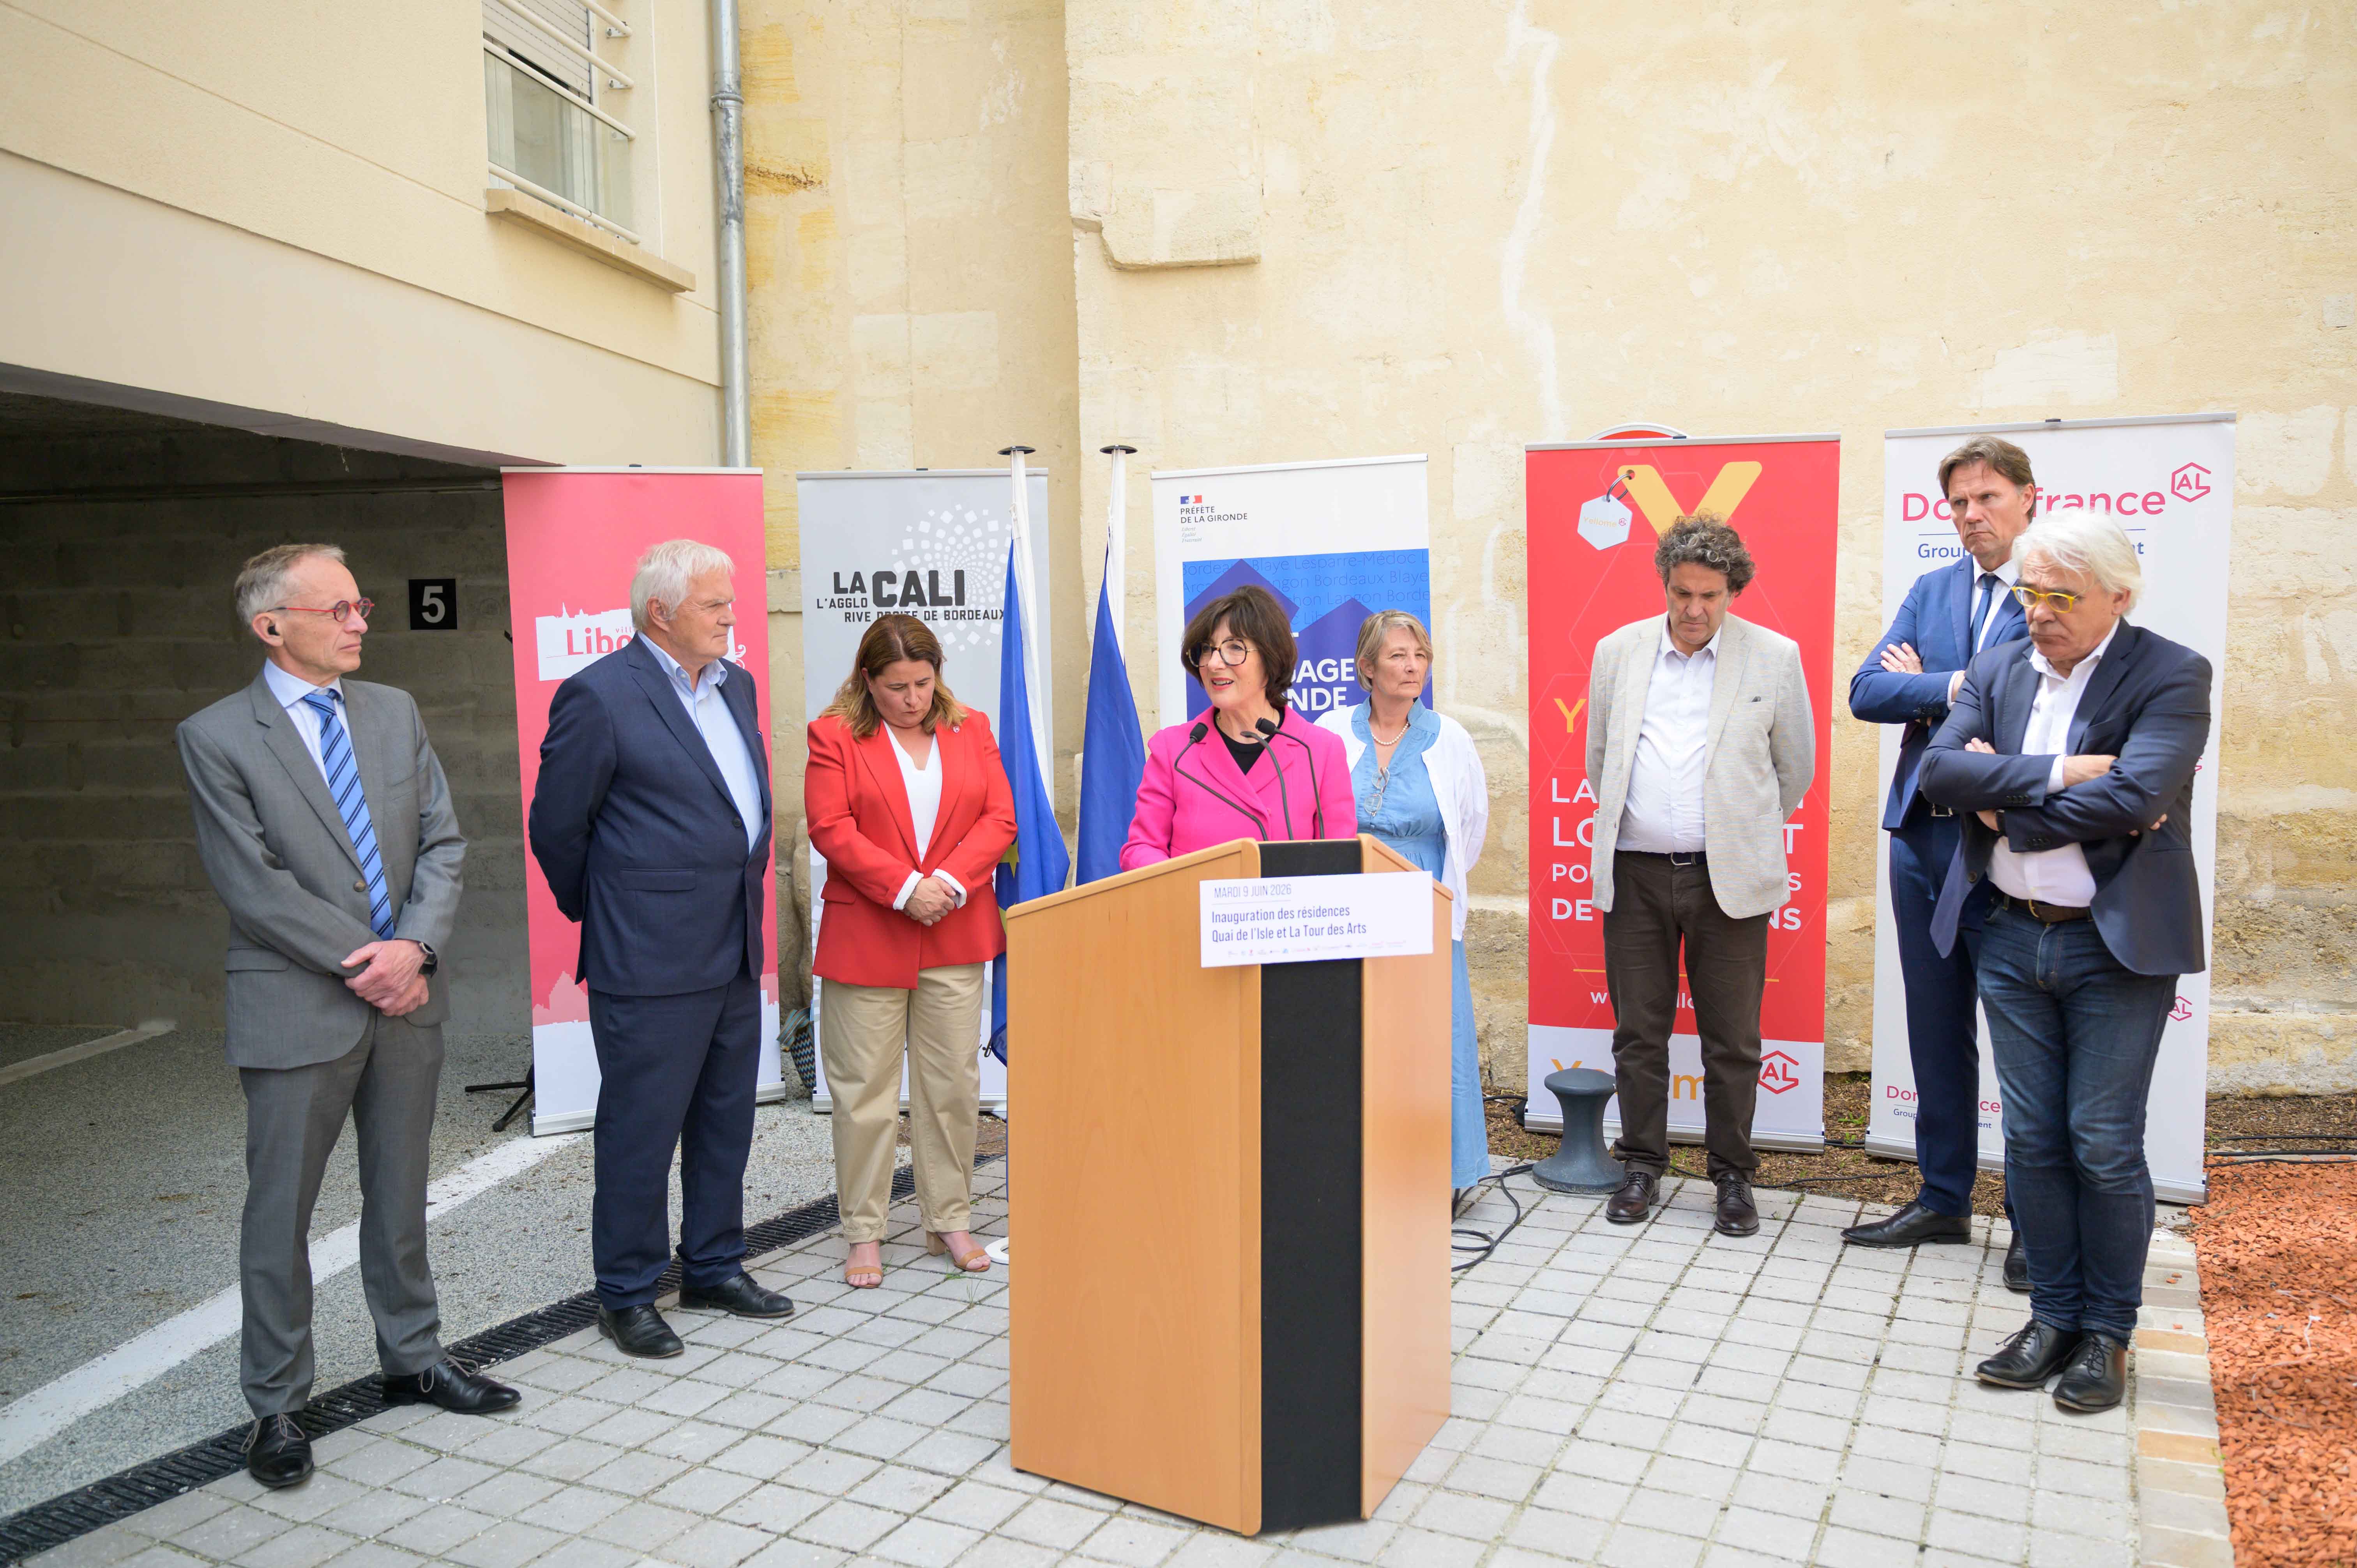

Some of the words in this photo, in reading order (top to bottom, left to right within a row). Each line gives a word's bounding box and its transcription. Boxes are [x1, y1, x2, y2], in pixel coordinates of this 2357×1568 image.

[1180, 506, 1215, 515] PRÉFÈTE
[1207, 513, 1247, 522] GIRONDE
[1315, 572, 1384, 586] Bordeaux
[1390, 570, 1428, 586] Blaye
[834, 572, 866, 594] LA
[872, 570, 965, 607] CALI
[422, 586, 445, 623] 5
[817, 598, 868, 609] L'AGGLO
[845, 611, 871, 622] RIVE
[924, 610, 938, 621] DE
[944, 609, 1004, 621] BORDEAUX
[567, 627, 633, 655] Libo
[1214, 886, 1240, 898] MARDI
[1244, 886, 1248, 897] 9
[1251, 885, 1268, 897] JUIN
[1270, 884, 1292, 895] 2026
[1212, 909, 1274, 924] Inauguration
[1278, 907, 1294, 919] des
[1298, 906, 1350, 918] résidences
[1212, 929, 1233, 942] Quai
[1237, 929, 1247, 941] de
[1277, 927, 1286, 938] et
[1290, 926, 1300, 937] La
[1303, 925, 1324, 936] Tour
[1328, 923, 1344, 935] des
[1347, 922, 1366, 934] Arts
